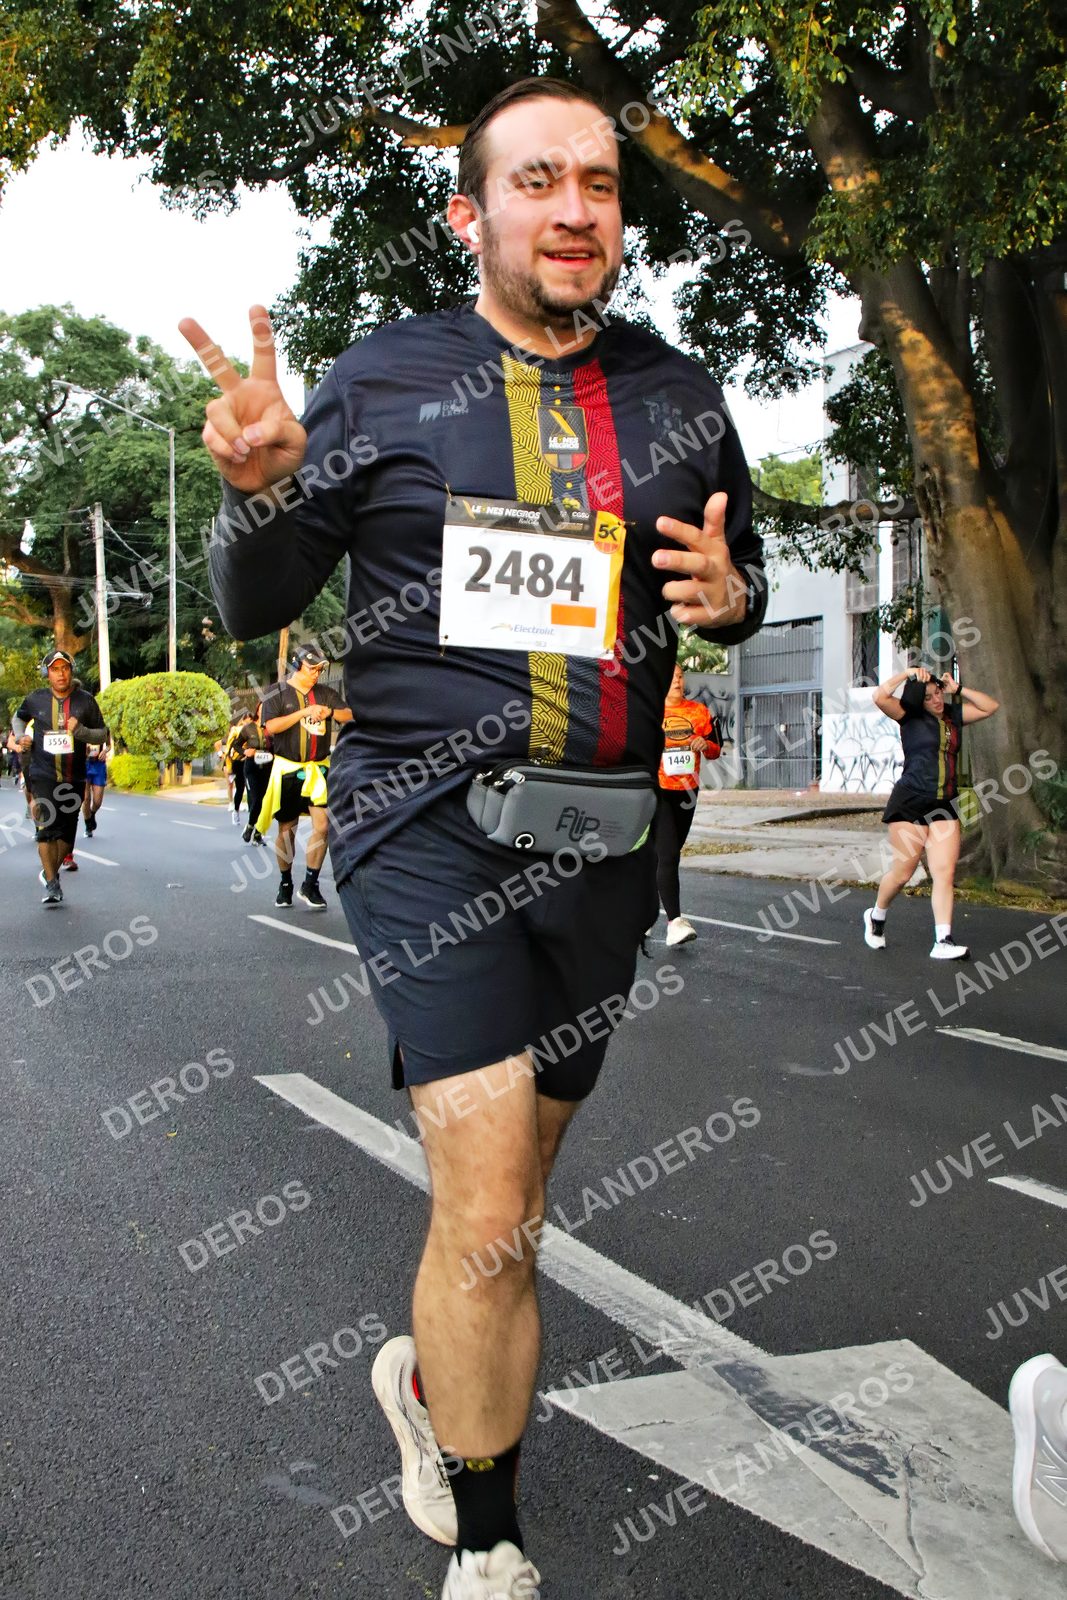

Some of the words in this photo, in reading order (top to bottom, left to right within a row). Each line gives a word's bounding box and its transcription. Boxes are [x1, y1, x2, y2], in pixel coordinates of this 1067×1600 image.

[505, 507, 541, 519] NEGROS
[465, 545, 584, 602] 2484
[48, 738, 68, 746] 3556
[668, 755, 691, 765] 1449
